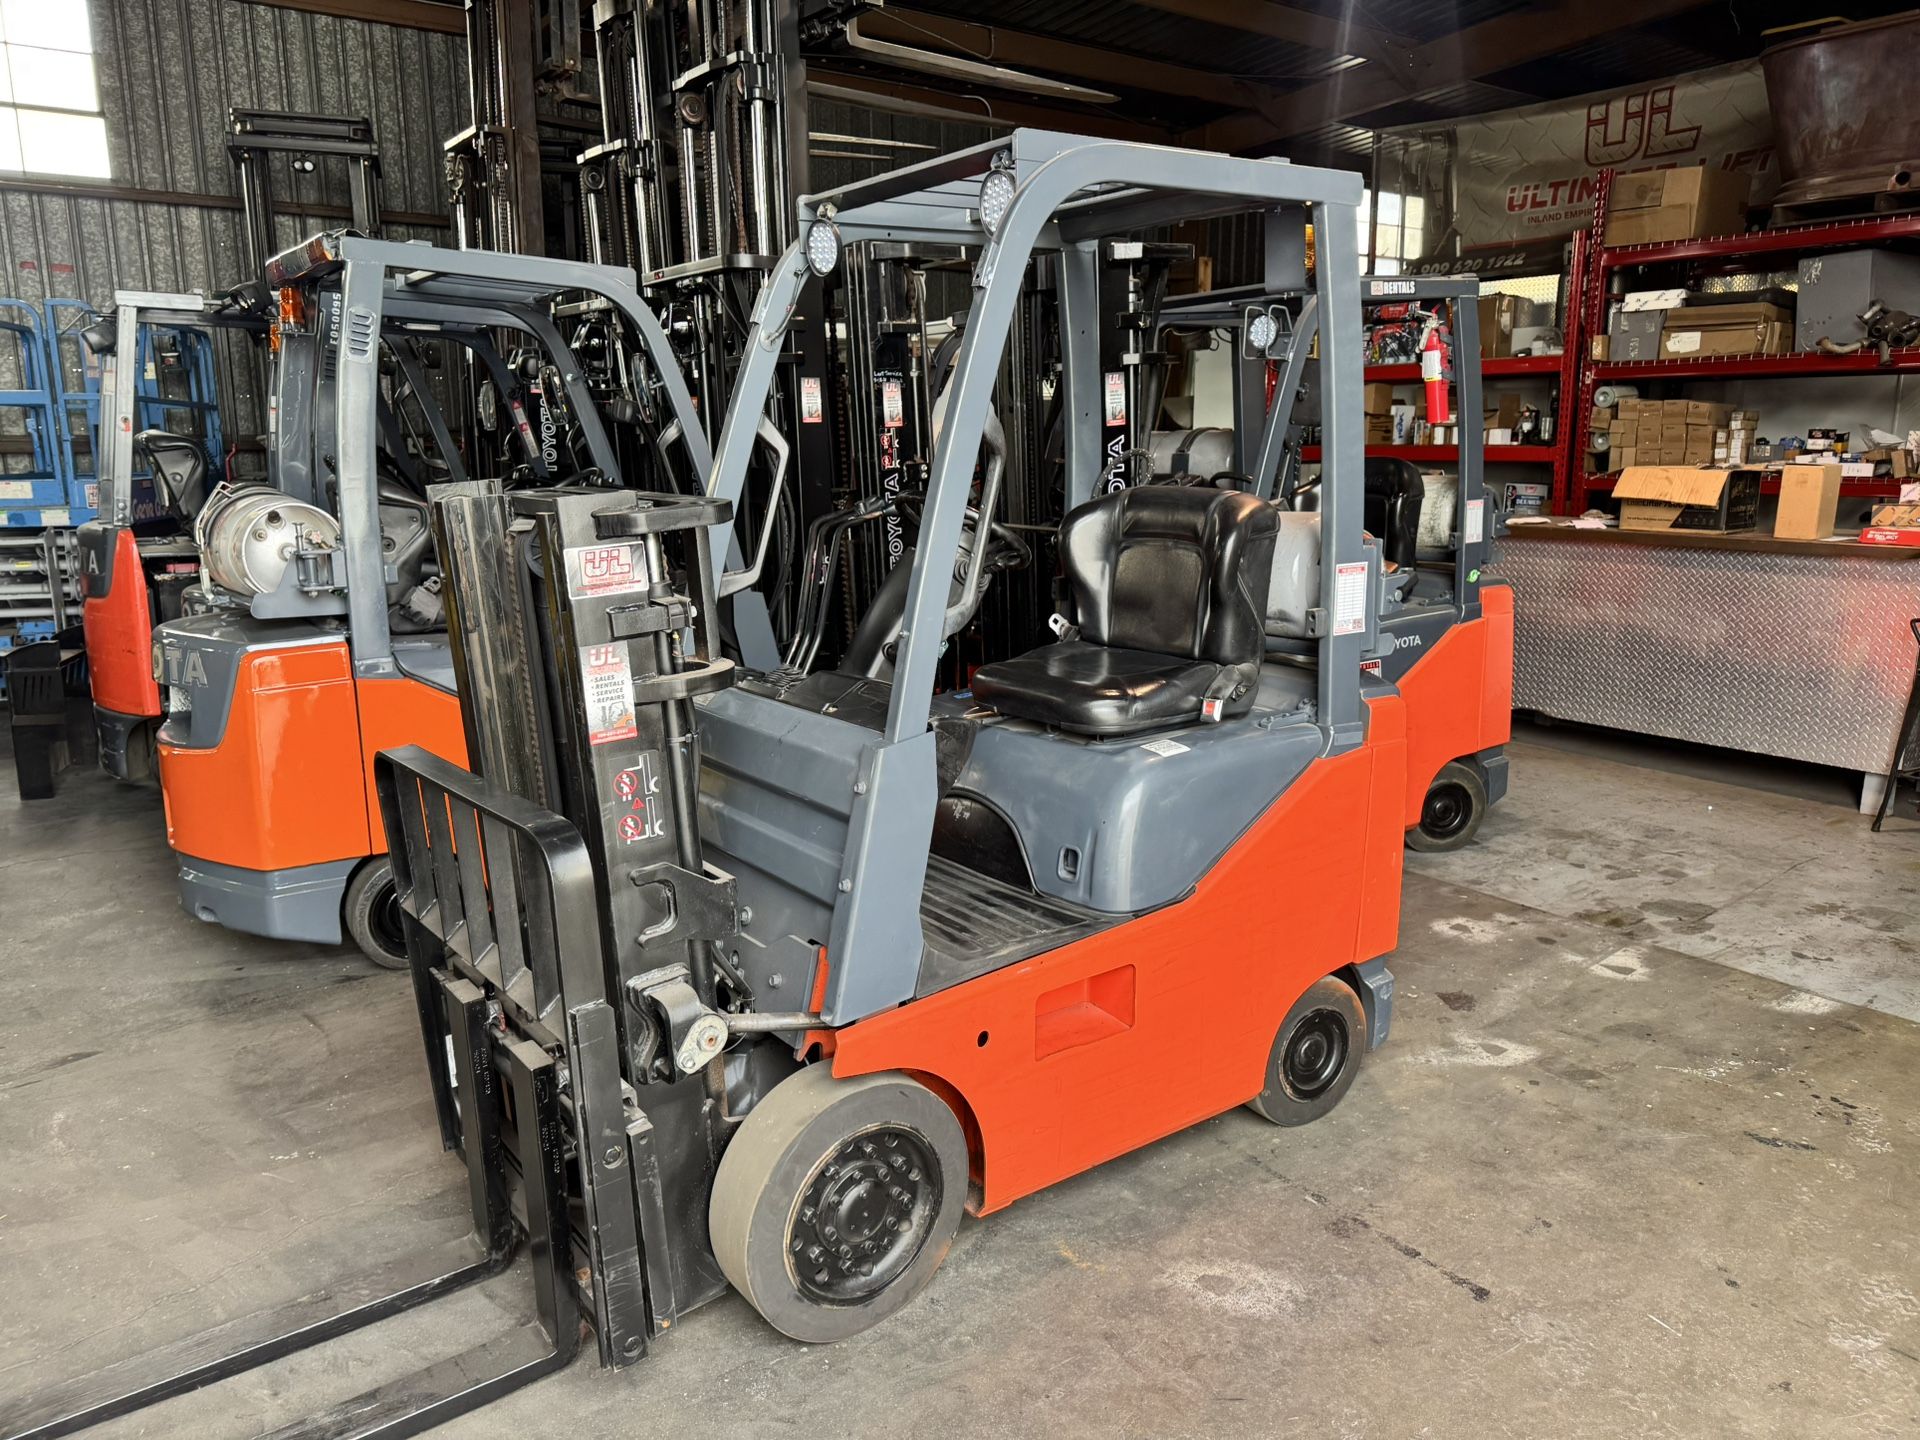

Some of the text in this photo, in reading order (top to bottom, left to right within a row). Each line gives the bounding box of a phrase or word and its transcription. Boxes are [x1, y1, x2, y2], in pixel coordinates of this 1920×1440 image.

[1584, 85, 1702, 167] UL
[1528, 209, 1594, 224] INLAND EMPIR
[1453, 258, 1484, 274] 620
[1487, 252, 1527, 269] 1922
[1384, 281, 1416, 295] RENTALS
[540, 398, 558, 472] TOYOT
[1107, 434, 1126, 495] OTA
[584, 548, 631, 578] UL
[1395, 635, 1422, 649] YOTA
[589, 645, 621, 667] UL
[594, 674, 615, 683] SALES
[595, 680, 625, 689] RENTALS
[596, 687, 624, 697] SERVICE
[597, 694, 625, 703] REPAIRS
